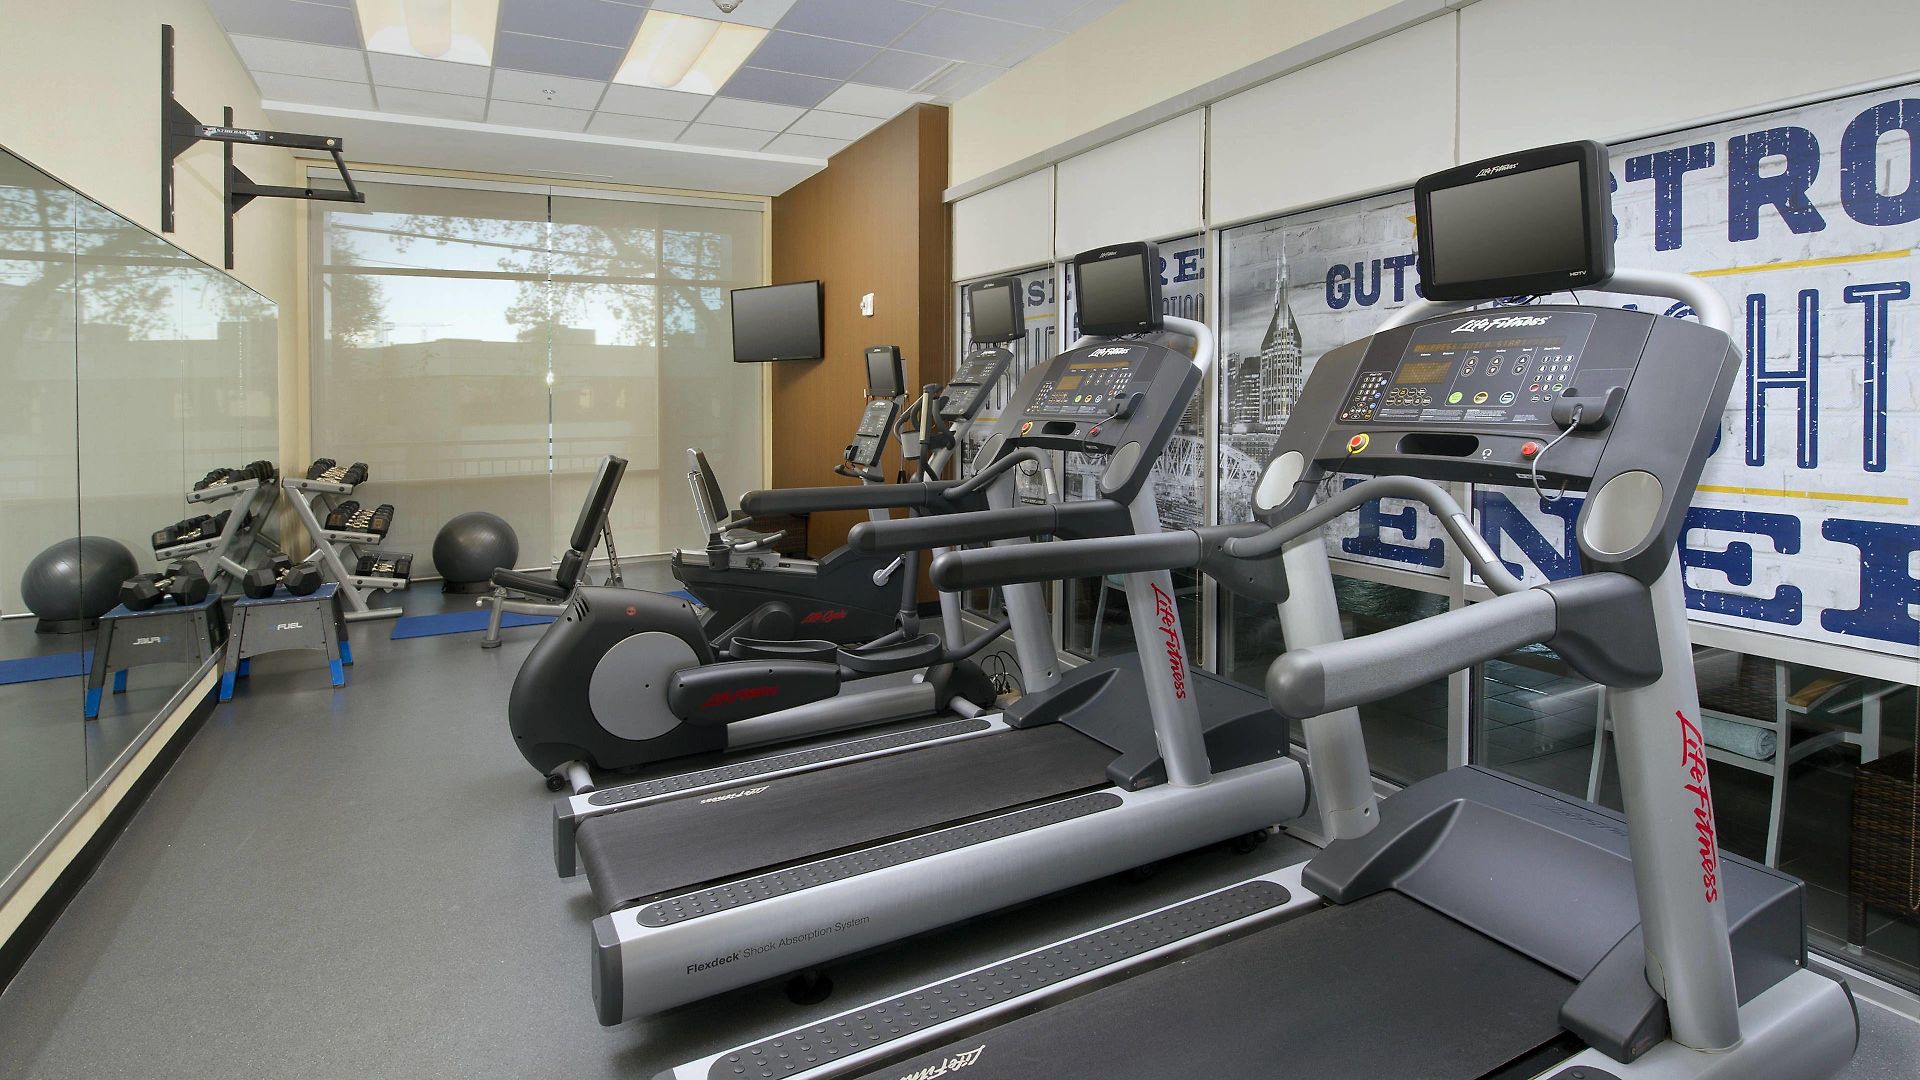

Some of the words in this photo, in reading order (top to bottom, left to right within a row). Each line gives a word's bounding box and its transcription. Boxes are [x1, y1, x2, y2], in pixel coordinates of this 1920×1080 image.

[1608, 98, 1920, 252] TRO
[1326, 254, 1425, 310] GUT
[1569, 269, 1587, 277] HDTV
[1451, 318, 1489, 333] Life
[1484, 316, 1549, 331] Fitness
[1150, 582, 1176, 627] Life
[1158, 625, 1186, 699] Fitness
[1675, 709, 1708, 784] Life
[1683, 783, 1718, 903] Fitness
[686, 952, 739, 975] Flexdeck
[743, 942, 776, 959] Shock
[778, 926, 832, 949] Absorption
[834, 915, 870, 933] System
[948, 1044, 986, 1072] Life
